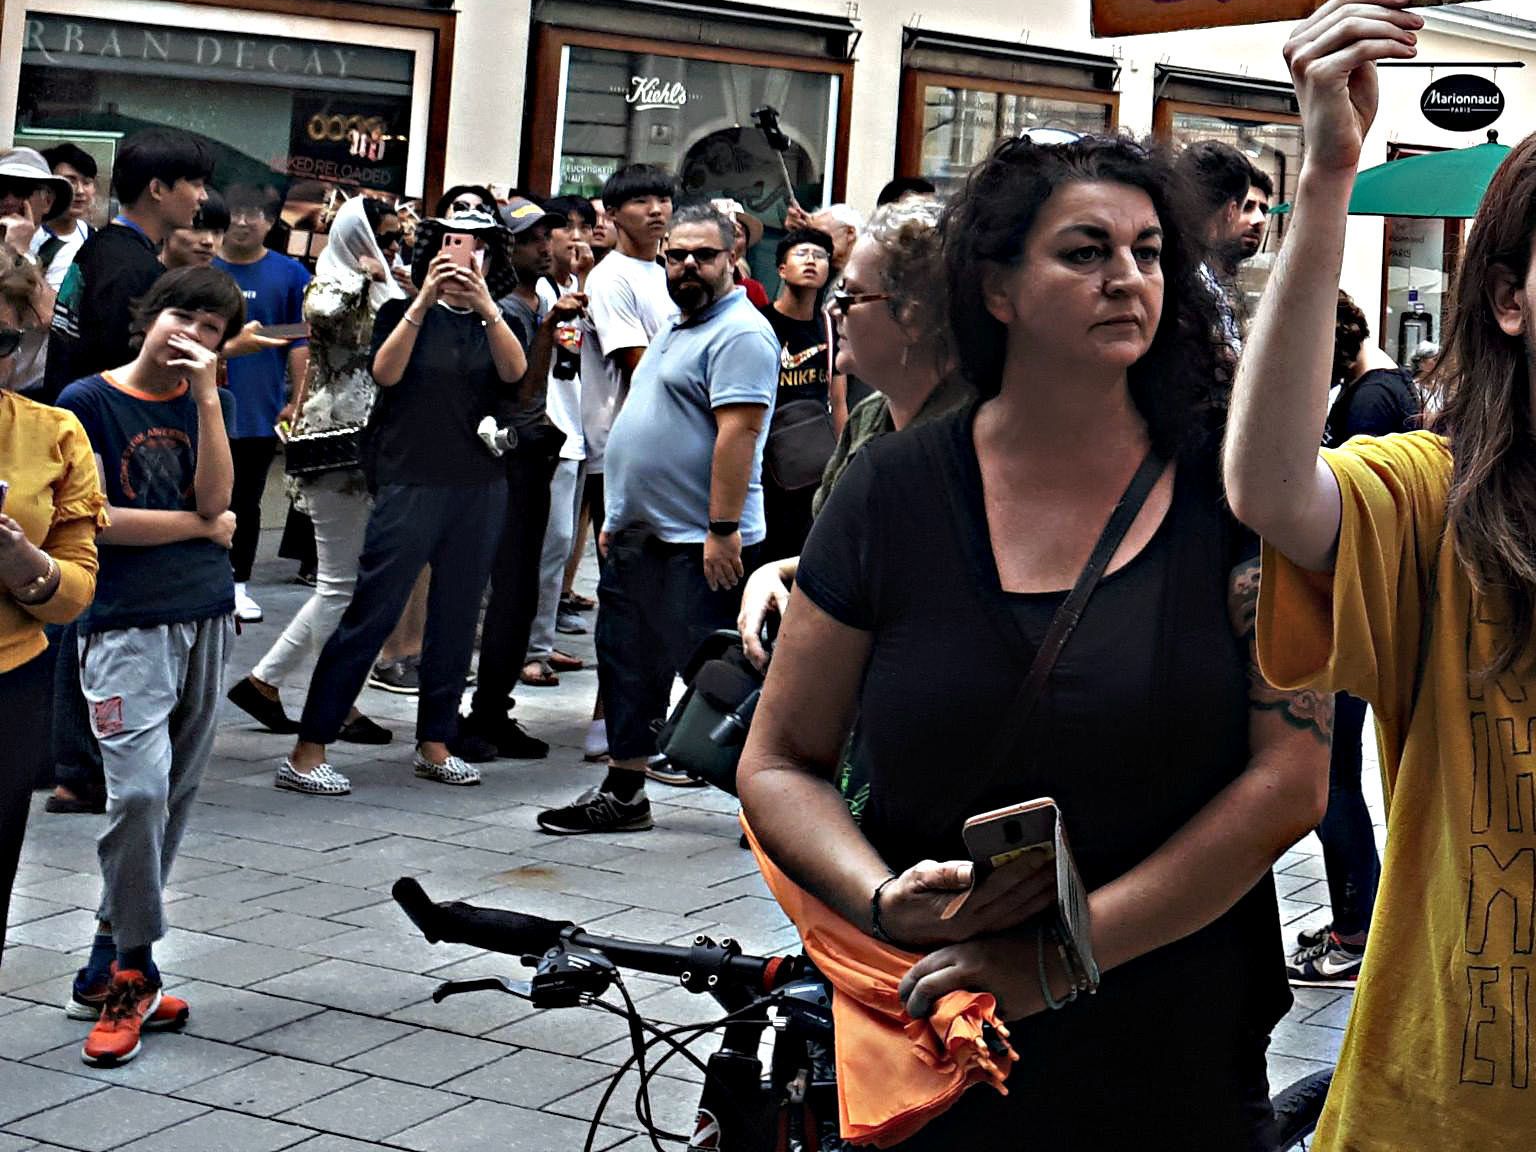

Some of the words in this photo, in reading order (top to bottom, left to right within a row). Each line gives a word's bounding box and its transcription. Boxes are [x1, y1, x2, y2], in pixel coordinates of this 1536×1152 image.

[196, 35, 356, 77] DECAY
[624, 75, 688, 105] Kiehl's
[1423, 88, 1500, 108] Marionnaud
[314, 159, 392, 186] RELOADED
[779, 368, 818, 387] NIKE
